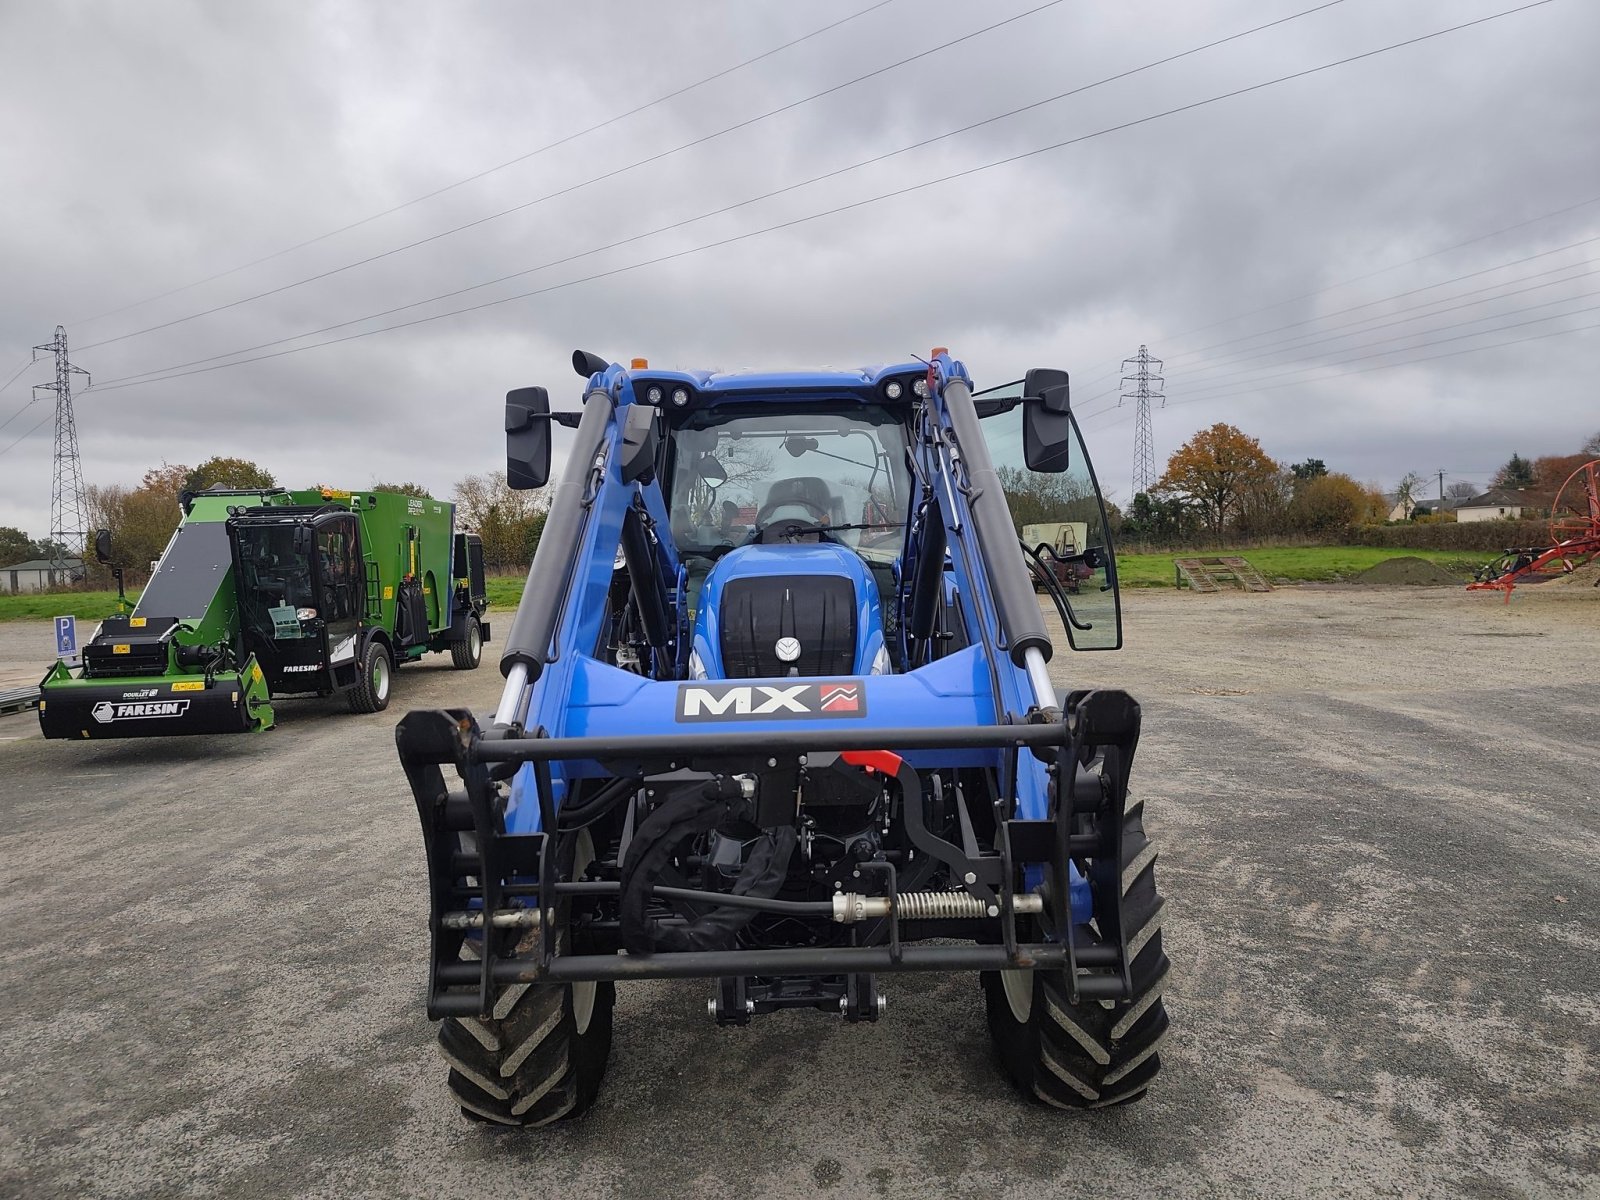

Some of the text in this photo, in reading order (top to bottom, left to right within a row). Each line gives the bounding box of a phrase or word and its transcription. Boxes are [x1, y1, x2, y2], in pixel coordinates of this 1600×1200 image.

[60, 618, 70, 636] P
[283, 664, 318, 673] FARESIN
[684, 685, 812, 716] MX
[117, 703, 178, 717] FARESIN
